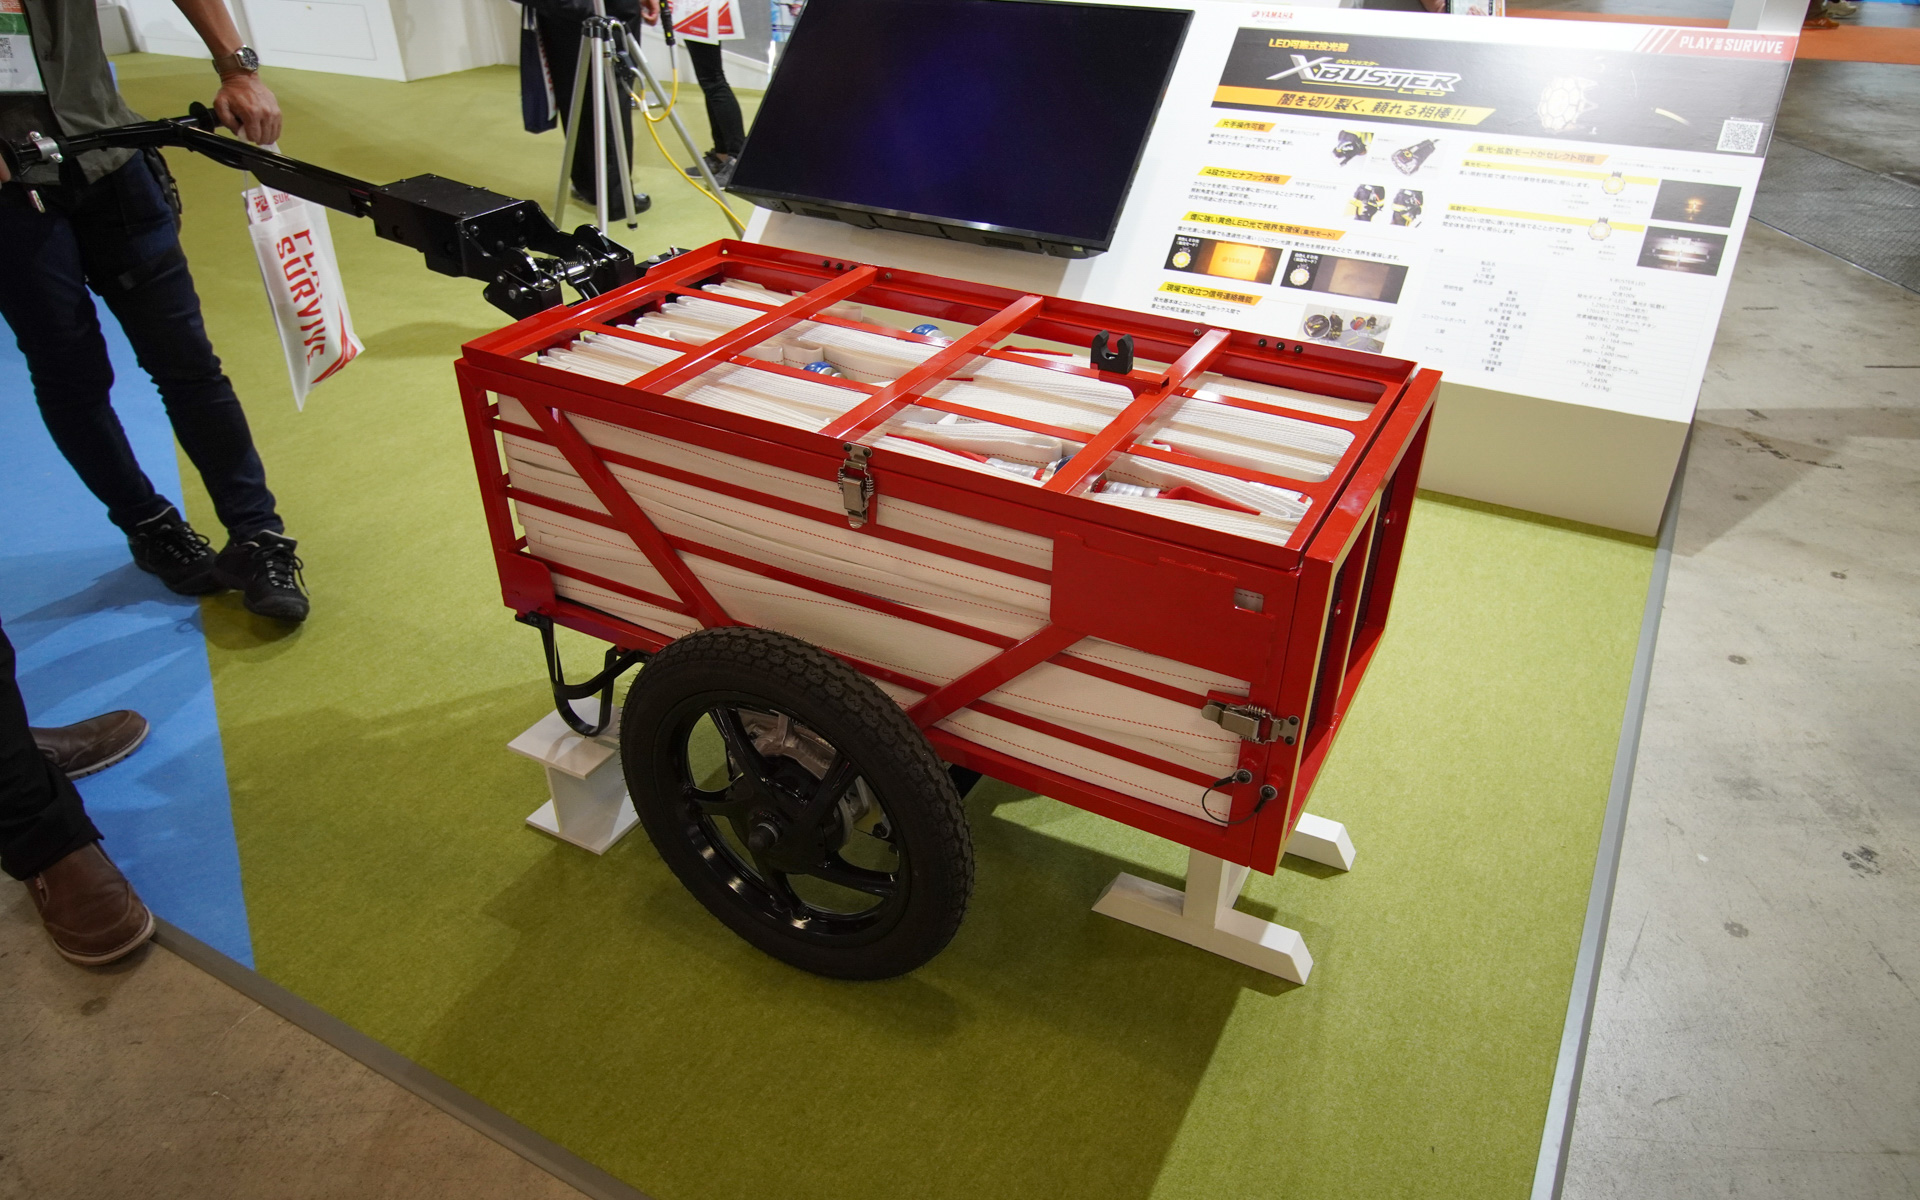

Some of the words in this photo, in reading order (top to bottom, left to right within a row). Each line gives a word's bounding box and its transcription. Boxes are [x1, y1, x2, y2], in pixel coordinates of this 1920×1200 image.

[1261, 10, 1293, 19] YAMAHA
[1679, 36, 1714, 50] PLAY
[1725, 38, 1784, 54] SURVIVE
[1397, 88, 1446, 97] LED
[1222, 120, 1266, 131] 片手操作可能
[1205, 168, 1281, 183] 4段カラビナフック採用
[277, 235, 326, 366] SURVIVE
[1166, 283, 1254, 304] 現場で役立つ信号連絡機能
